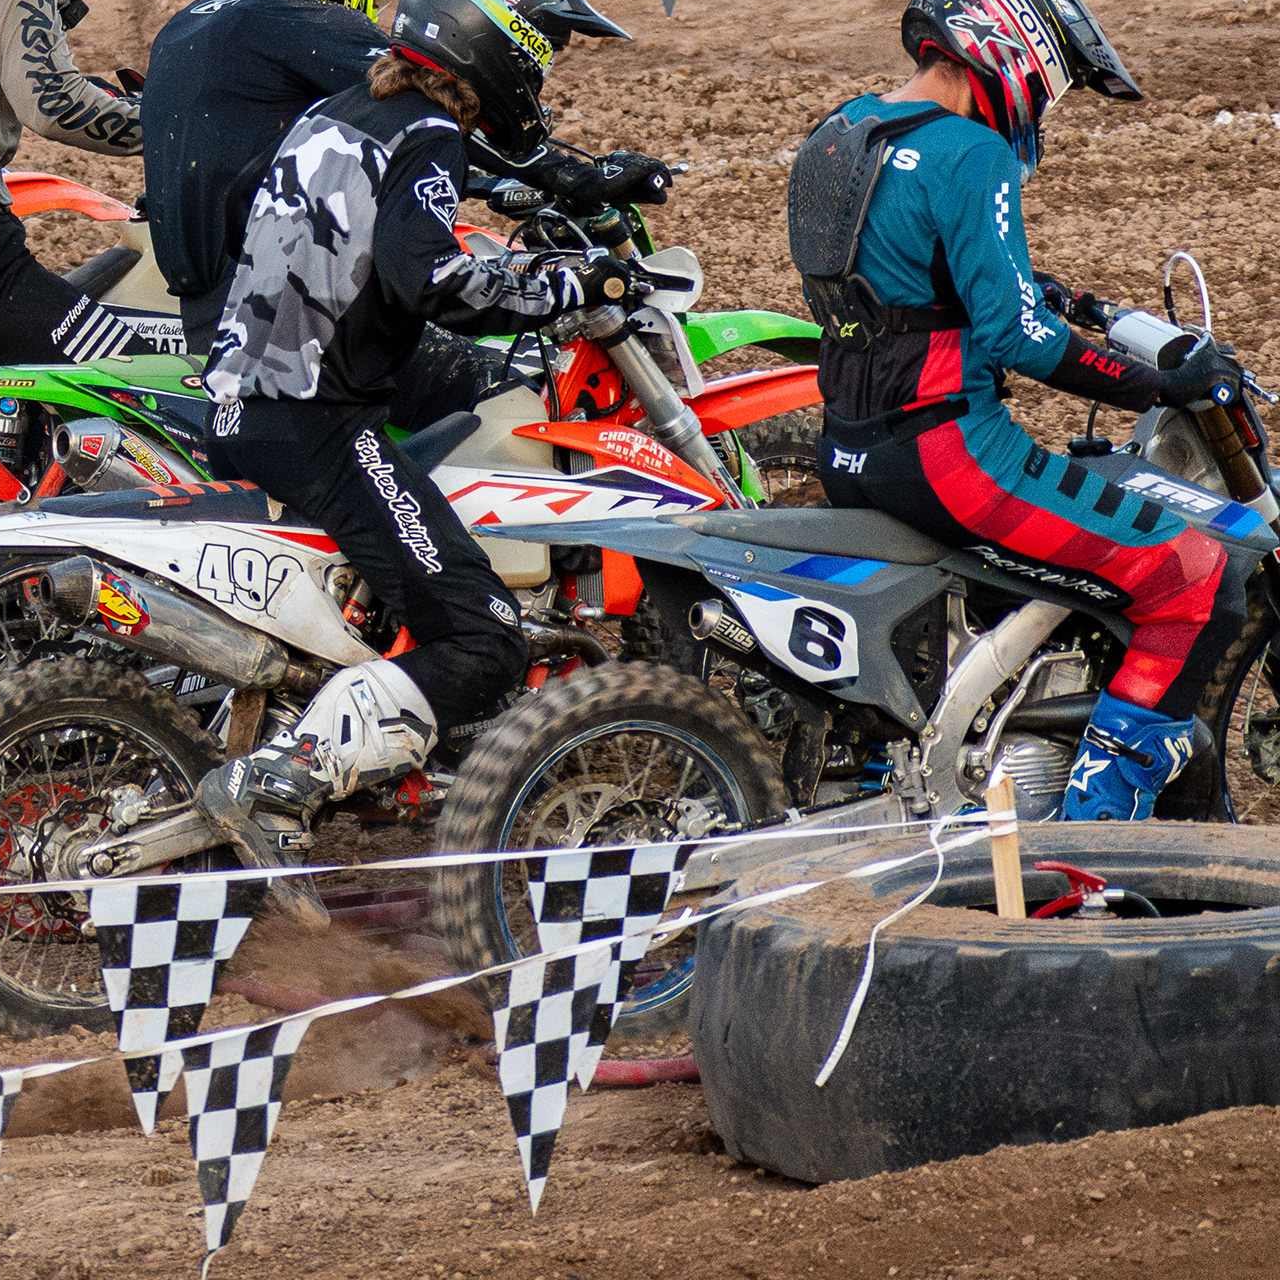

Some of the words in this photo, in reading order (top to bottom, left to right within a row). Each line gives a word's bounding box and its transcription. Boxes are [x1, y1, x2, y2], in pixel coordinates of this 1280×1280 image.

[509, 19, 550, 57] OAKLEY
[502, 189, 544, 203] flexx
[135, 323, 157, 336] Kurt
[122, 439, 169, 485] CIRCUIT
[833, 448, 868, 474] FH
[368, 460, 400, 500] Lee
[388, 488, 443, 575] Designs
[724, 622, 757, 653] HGS
[788, 604, 848, 672] 6
